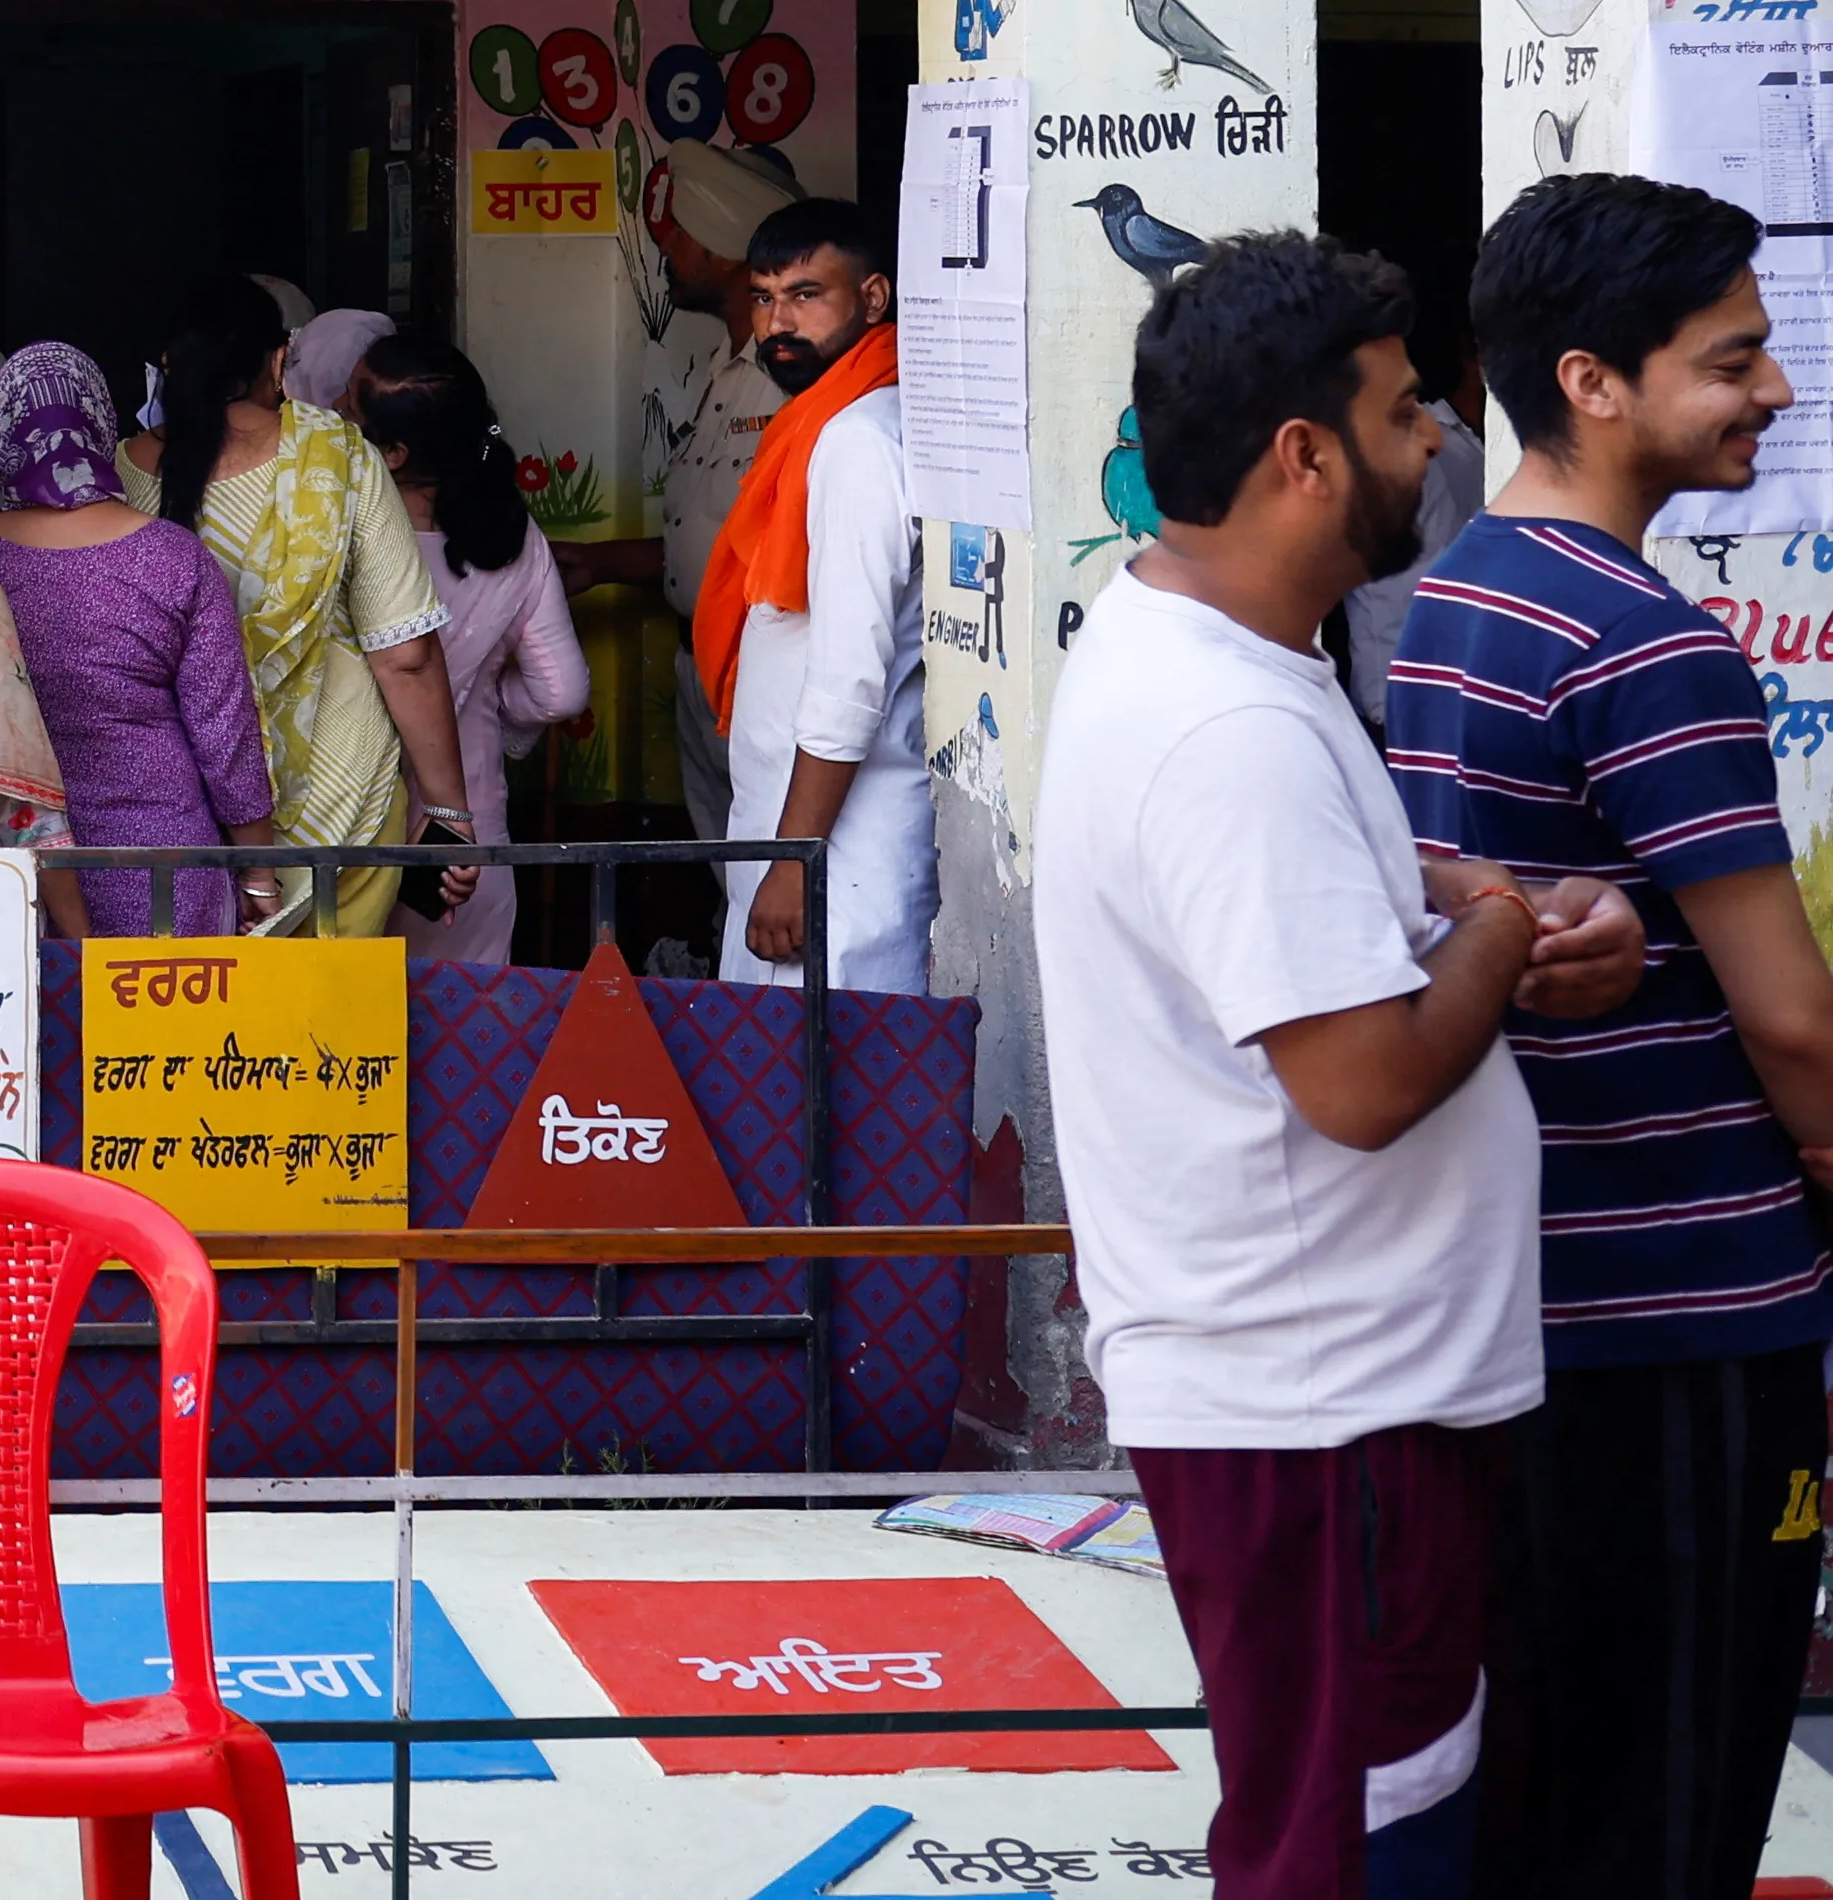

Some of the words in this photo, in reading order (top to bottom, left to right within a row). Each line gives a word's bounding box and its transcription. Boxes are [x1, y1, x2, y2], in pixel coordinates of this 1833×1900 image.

[492, 49, 516, 103] 1
[552, 54, 599, 110] 3
[1503, 40, 1545, 89] LIPS
[666, 72, 702, 122] 6
[744, 62, 789, 122] 8
[1034, 112, 1197, 160] SPARROW
[619, 155, 633, 197] 5
[485, 182, 601, 222] ਬਾਹਰ
[928, 608, 980, 654] ENGINEER
[107, 958, 237, 1009] ਵਰਗ
[538, 1094, 669, 1165] ਤਿਕੋਣ
